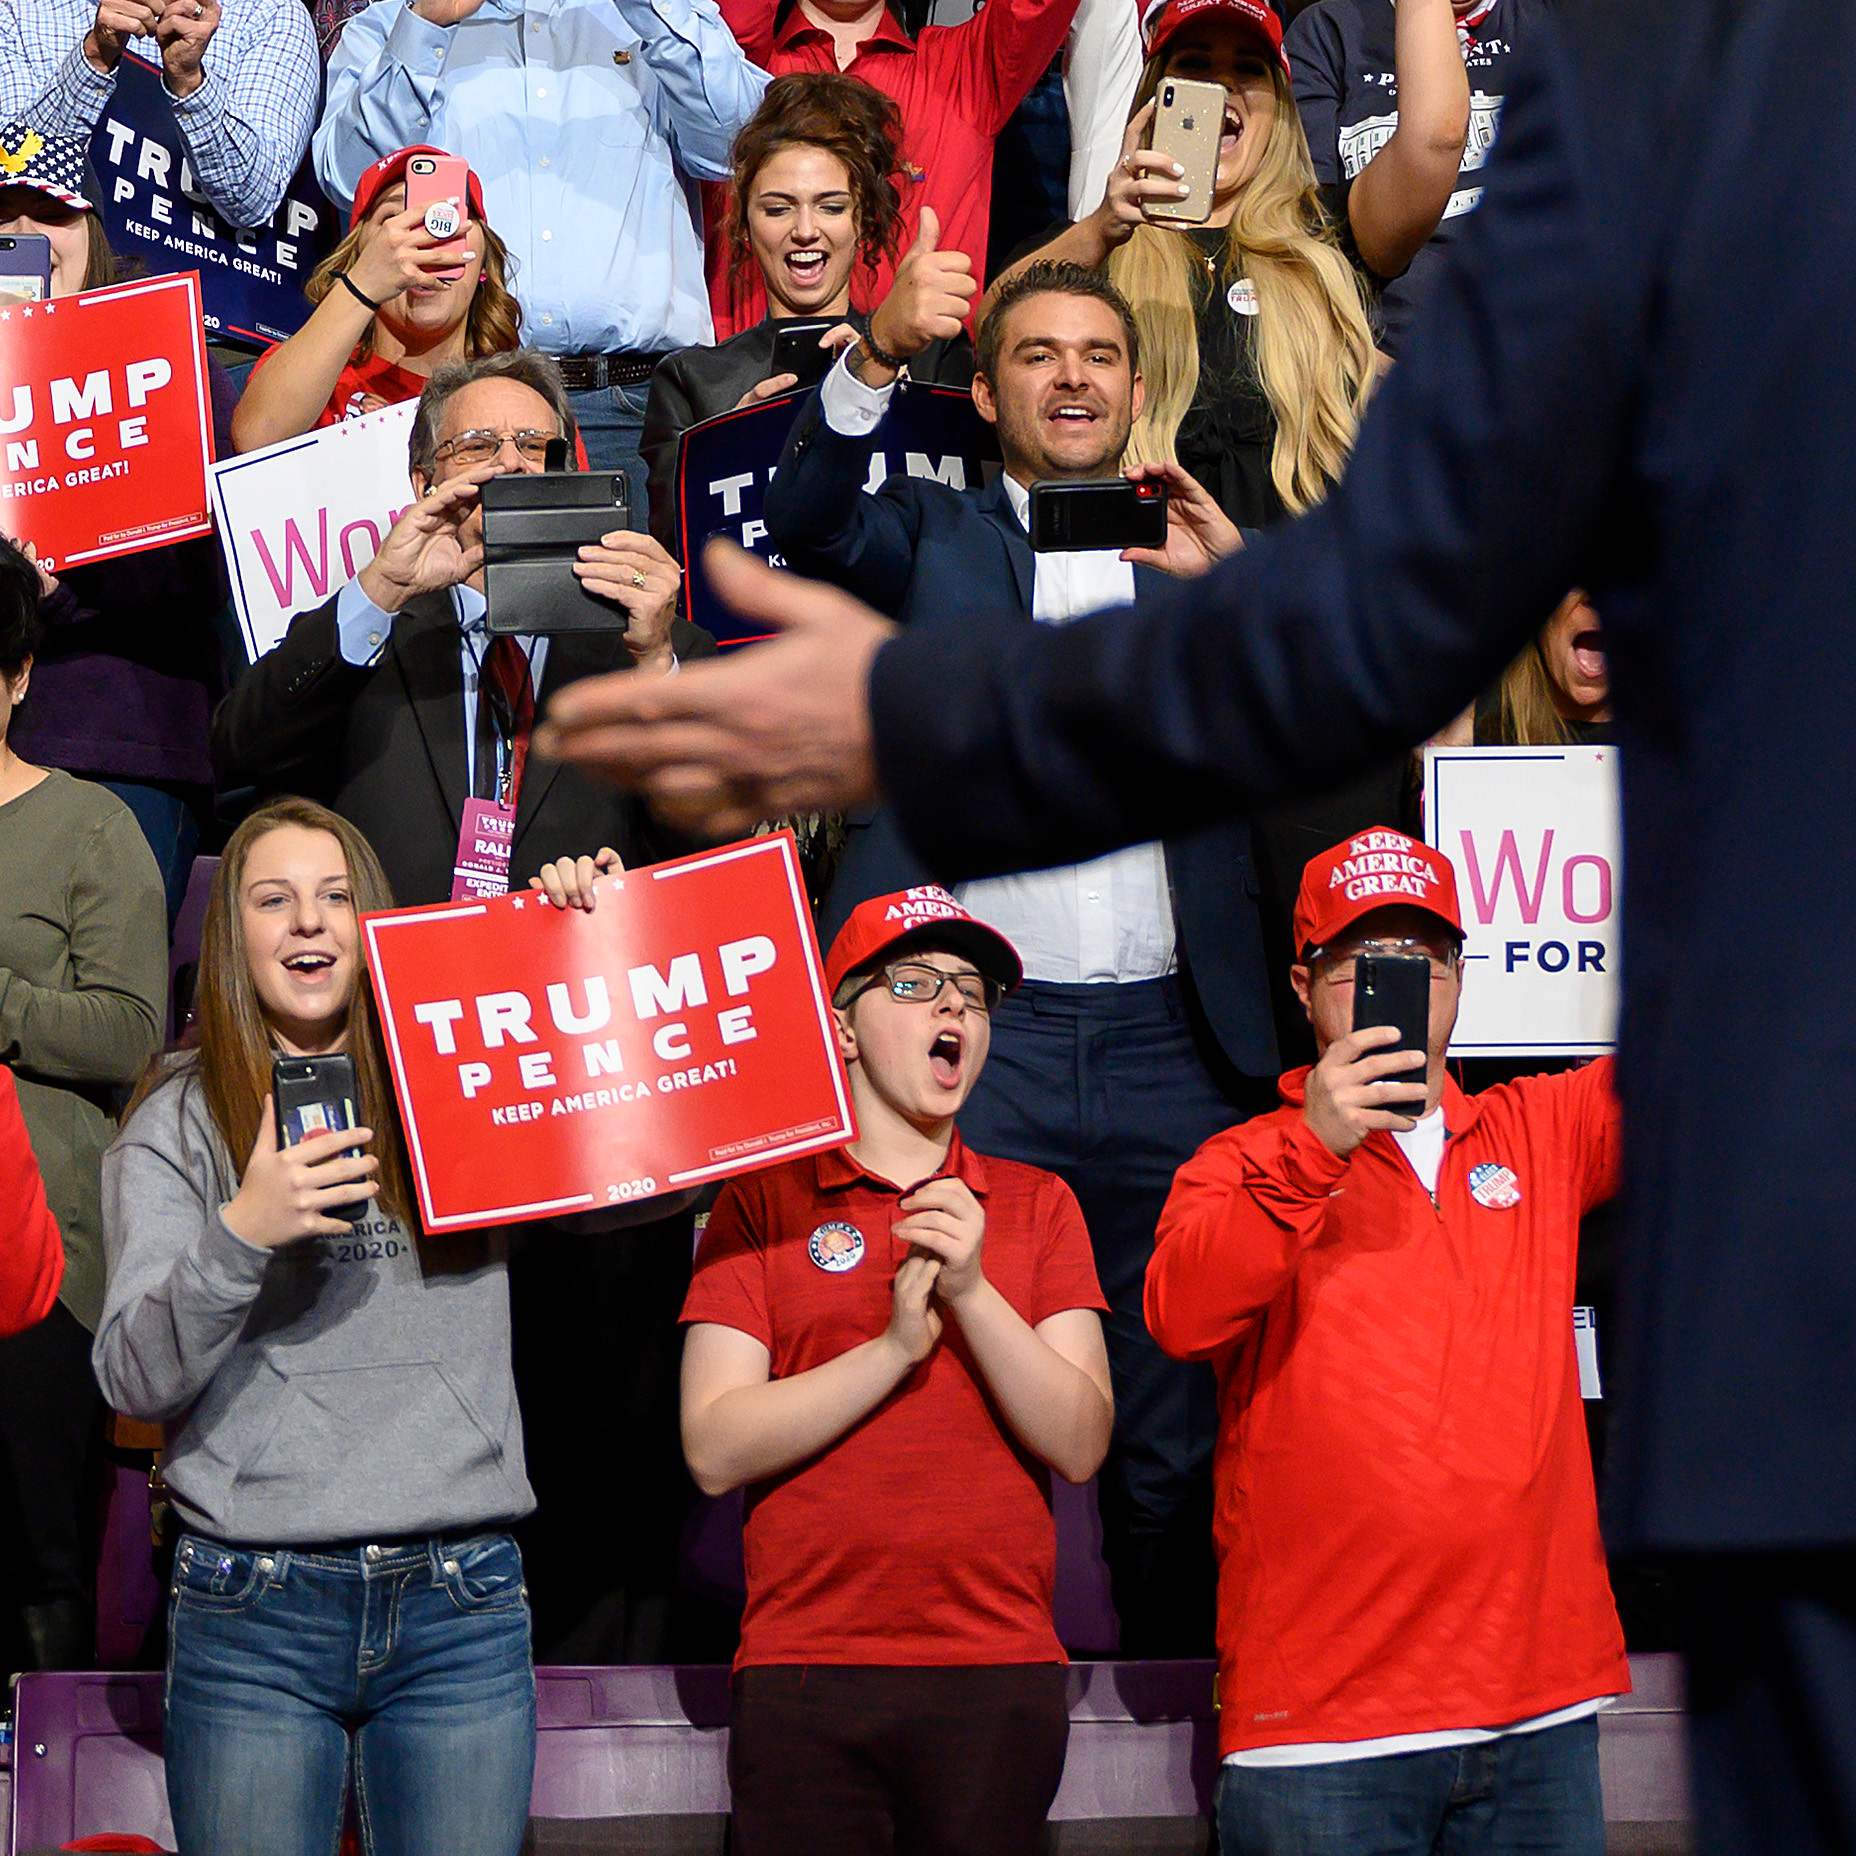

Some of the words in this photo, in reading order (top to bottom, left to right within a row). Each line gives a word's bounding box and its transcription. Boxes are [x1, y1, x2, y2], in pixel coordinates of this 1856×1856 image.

[124, 219, 160, 242] KEEP
[162, 225, 228, 271] AMERICA
[229, 256, 284, 287] GREAT!
[63, 461, 128, 489] GREAT!
[1349, 834, 1412, 854] KEEP
[1328, 855, 1441, 887] AMERICA
[1345, 875, 1428, 901] GREAT
[1506, 940, 1608, 974] FOR
[413, 934, 779, 1056] TRUMP
[458, 1004, 757, 1098] PENCE
[491, 1105, 545, 1126] KEEP
[550, 1083, 651, 1119] AMERICA
[656, 1064, 738, 1095] GREAT!
[606, 1178, 655, 1202] 2020
[337, 1241, 398, 1261] 2020
